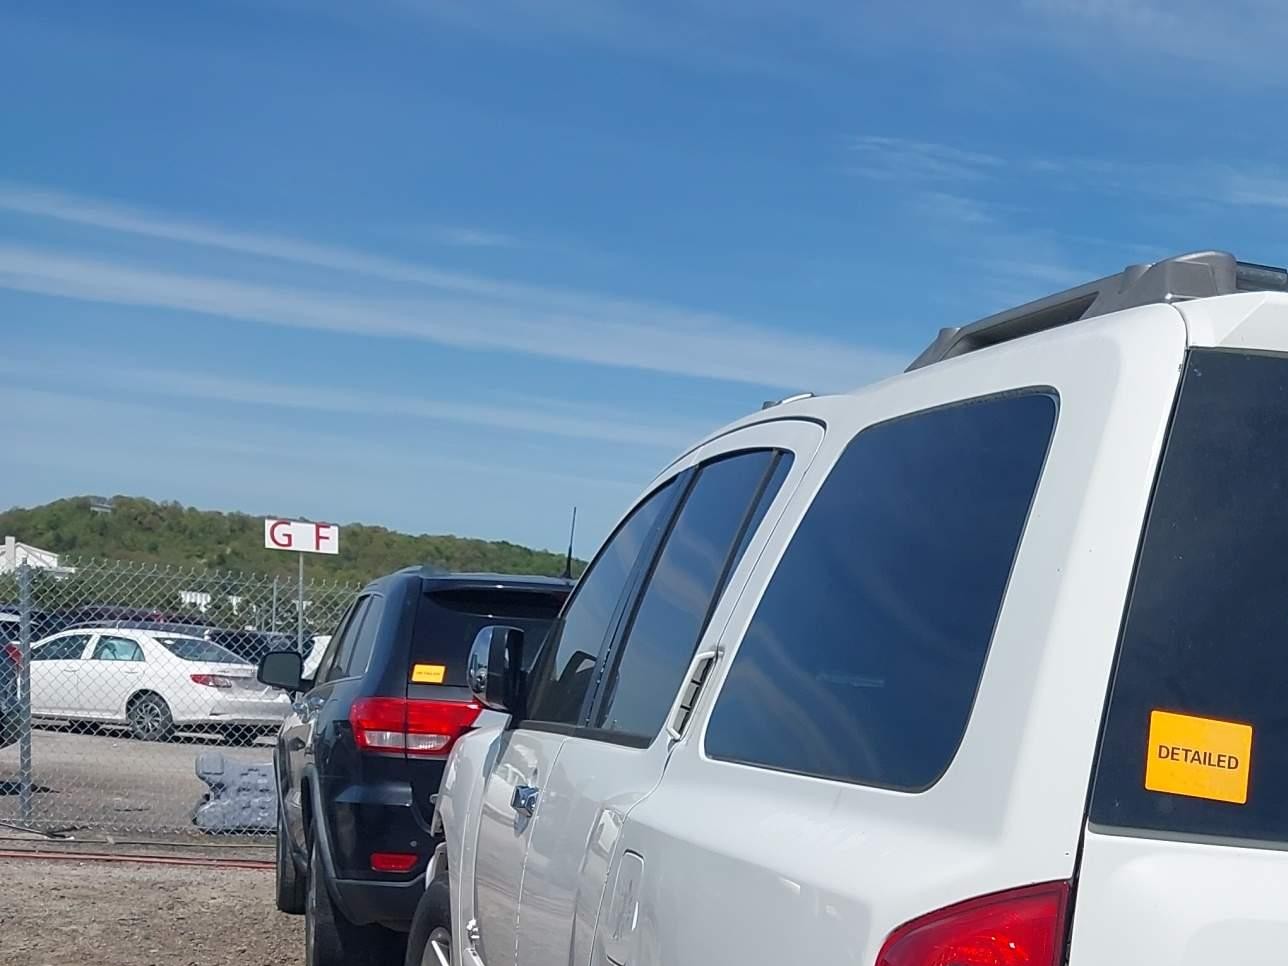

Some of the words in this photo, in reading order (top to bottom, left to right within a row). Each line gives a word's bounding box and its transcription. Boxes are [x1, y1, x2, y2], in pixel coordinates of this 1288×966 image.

[270, 521, 292, 548] G
[315, 523, 331, 551] F
[1158, 744, 1239, 770] DETAILED
